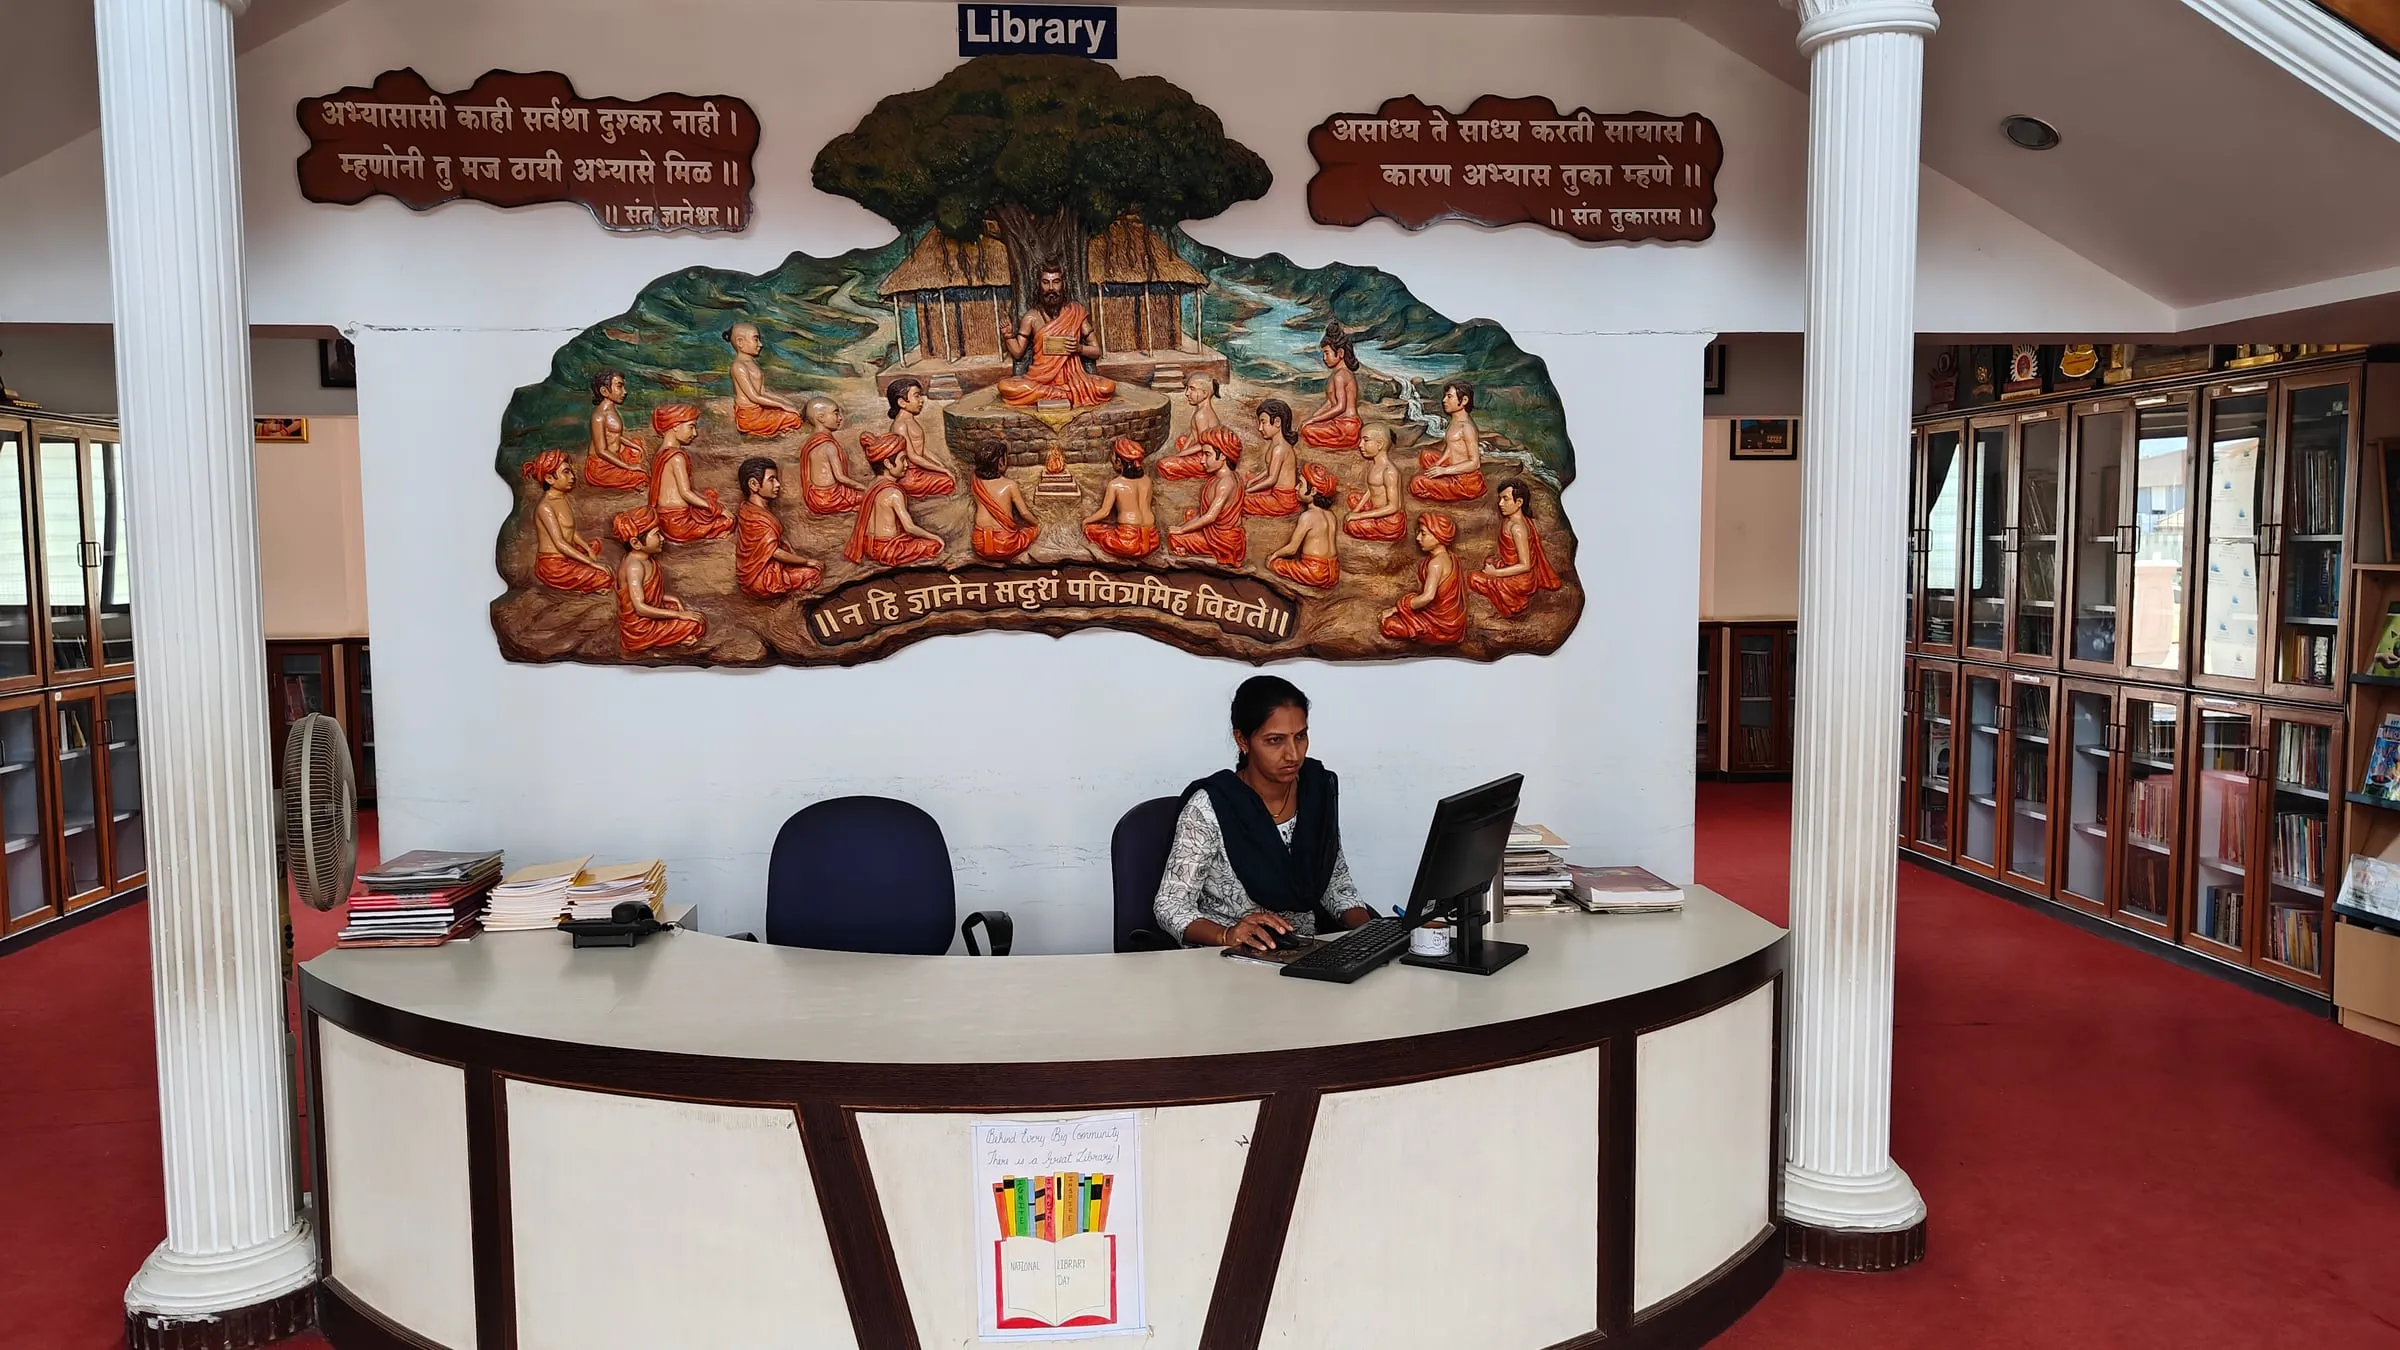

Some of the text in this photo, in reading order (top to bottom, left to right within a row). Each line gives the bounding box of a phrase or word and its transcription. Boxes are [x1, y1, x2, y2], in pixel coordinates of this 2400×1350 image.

[967, 9, 1106, 54] Library
[321, 95, 447, 129] अभ्यासासी
[453, 97, 513, 133] काही
[520, 97, 590, 132] सर्वथा
[597, 108, 663, 144] दुश्कर
[670, 101, 720, 137] नाही
[1332, 118, 1421, 143] असाध्य
[1429, 109, 1449, 142] ते
[1457, 118, 1521, 143] साध्य
[1529, 111, 1595, 143] करती
[1602, 121, 1684, 144] सायास
[338, 144, 425, 182] म्हणोनी
[432, 155, 453, 191] तु
[459, 156, 501, 181] मज
[508, 149, 563, 183] ठायी
[572, 149, 656, 184] अभ्यासे
[662, 150, 713, 184] मिळ
[1379, 164, 1452, 187] कारण
[1462, 163, 1551, 187] अभ्यास
[1560, 164, 1613, 196] तुका
[1621, 154, 1674, 189] म्हणे
[624, 198, 654, 224] संत
[659, 198, 719, 227] ज्ञानेश्वर
[1570, 201, 1602, 225] संत
[1608, 208, 1681, 233] तुकाराम
[867, 588, 899, 621] हि
[904, 574, 988, 615] ज्ञानेन
[1066, 571, 1191, 616] पवित्रमिह
[985, 1124, 1119, 1147] Behind Every Big Community
[988, 1149, 1008, 1165] There
[1014, 1156, 1025, 1165] is
[1028, 1156, 1038, 1165] a
[1017, 1180, 1025, 1225] IGNITE
[1010, 1259, 1085, 1272] NATIONAL LIBRARY
[1056, 1274, 1070, 1286] DAY
